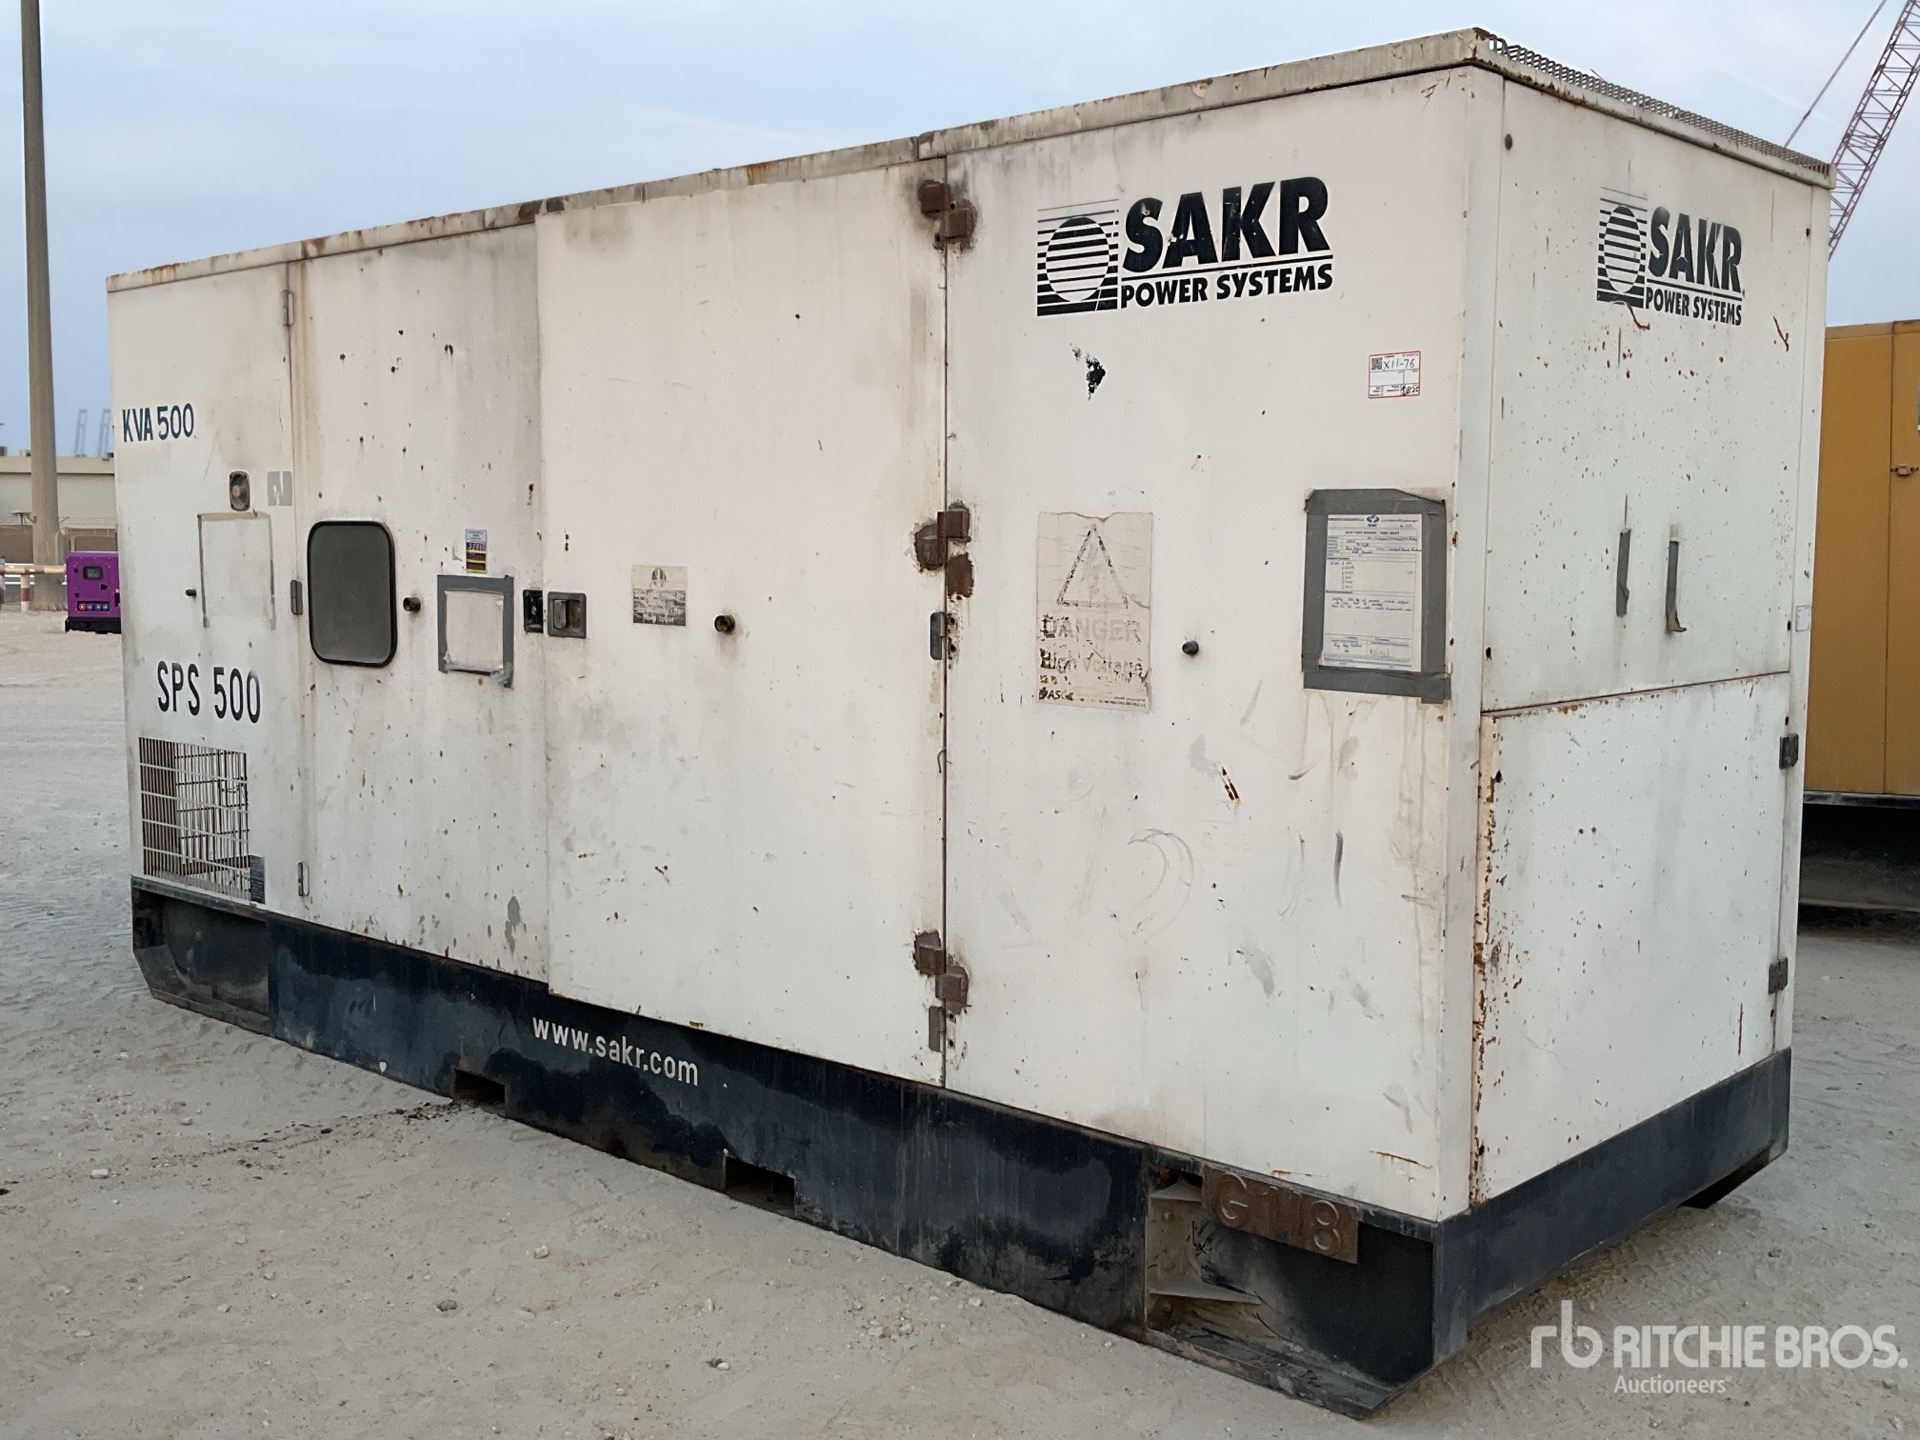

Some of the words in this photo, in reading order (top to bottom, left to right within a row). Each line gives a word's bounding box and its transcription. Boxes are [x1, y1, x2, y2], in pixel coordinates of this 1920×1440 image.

[1122, 176, 1331, 273] SAKR
[1648, 205, 1742, 294] SAKR
[1120, 277, 1209, 309] POWER
[1216, 263, 1334, 300] SYSTEMS
[1645, 286, 1690, 317] POWER
[1692, 295, 1742, 327] SYSTEMS
[122, 407, 153, 443] KVA
[156, 402, 195, 441] 500
[157, 660, 200, 716] SPS
[213, 666, 261, 724] 500
[532, 1016, 699, 1087] www.sakr.com
